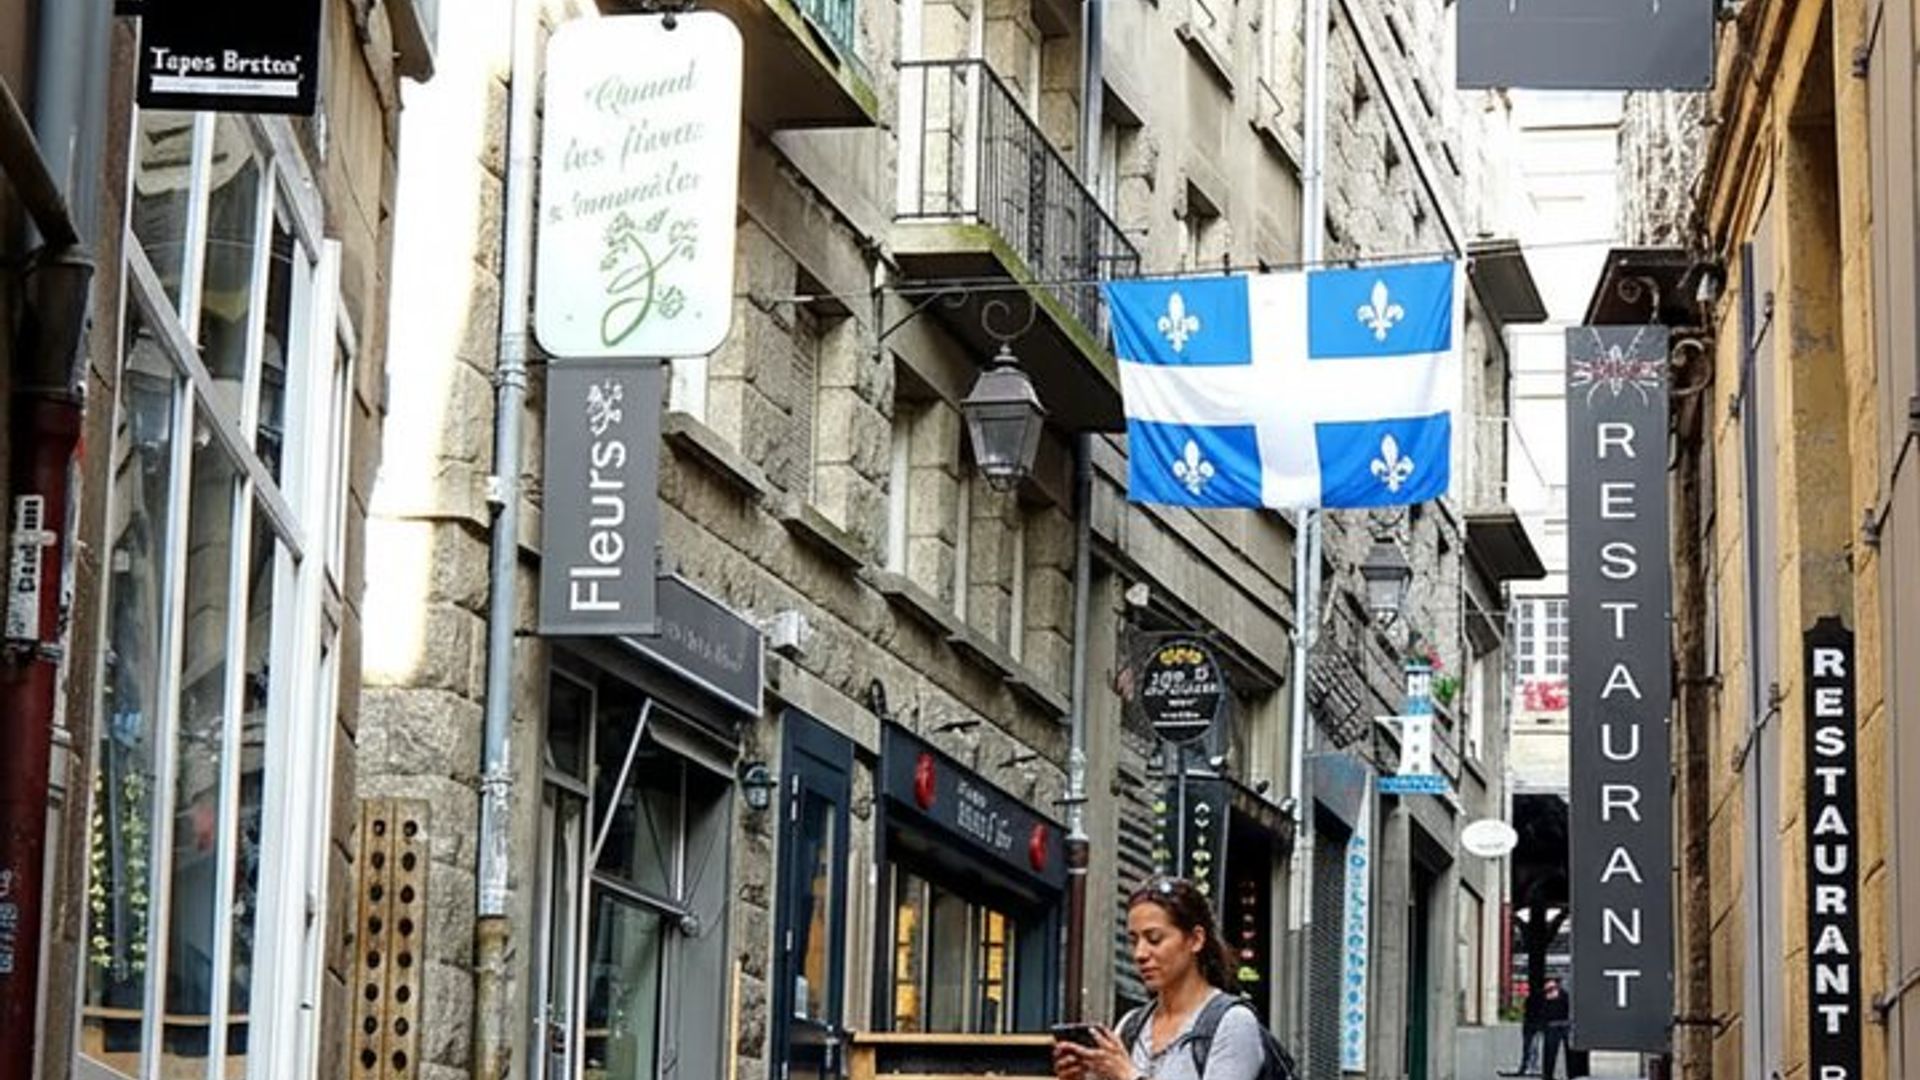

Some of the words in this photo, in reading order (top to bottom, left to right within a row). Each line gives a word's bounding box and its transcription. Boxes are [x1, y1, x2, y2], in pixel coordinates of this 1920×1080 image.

[570, 441, 626, 611] Fleurs
[1597, 422, 1643, 1007] RESTAURANT
[1813, 648, 1849, 1033] RESTAURANT
